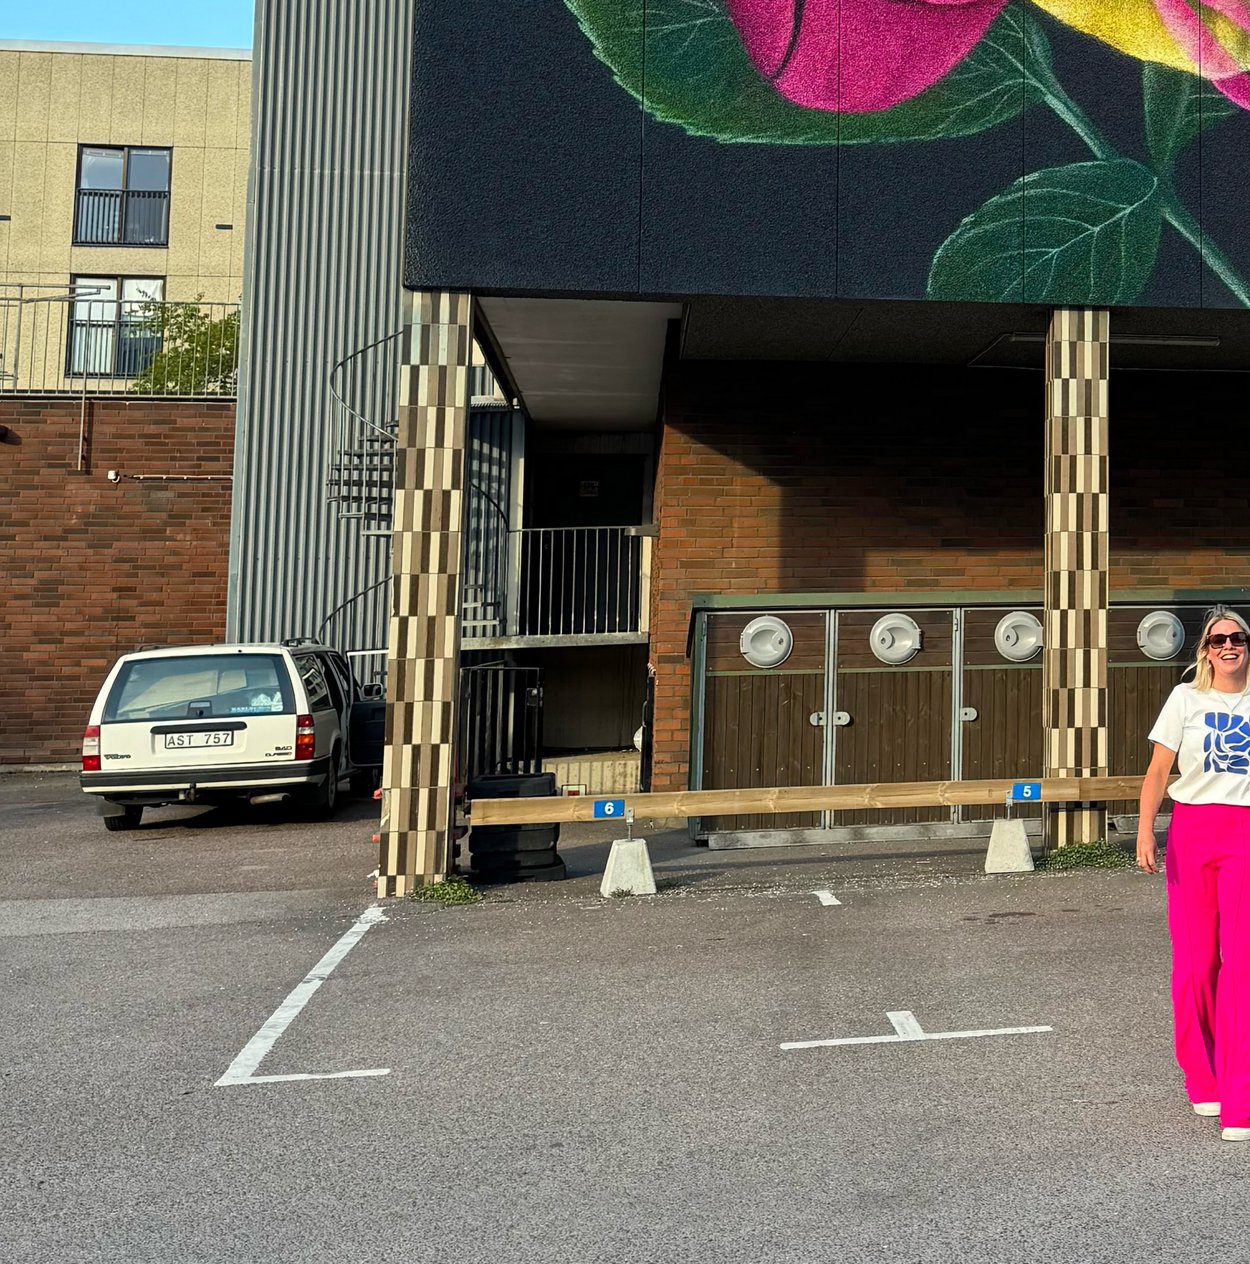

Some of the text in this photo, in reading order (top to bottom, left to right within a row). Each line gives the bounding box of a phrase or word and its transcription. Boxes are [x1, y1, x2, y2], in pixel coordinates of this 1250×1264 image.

[167, 732, 230, 746] AST 757
[1022, 785, 1032, 798] 5
[604, 801, 614, 815] 6
